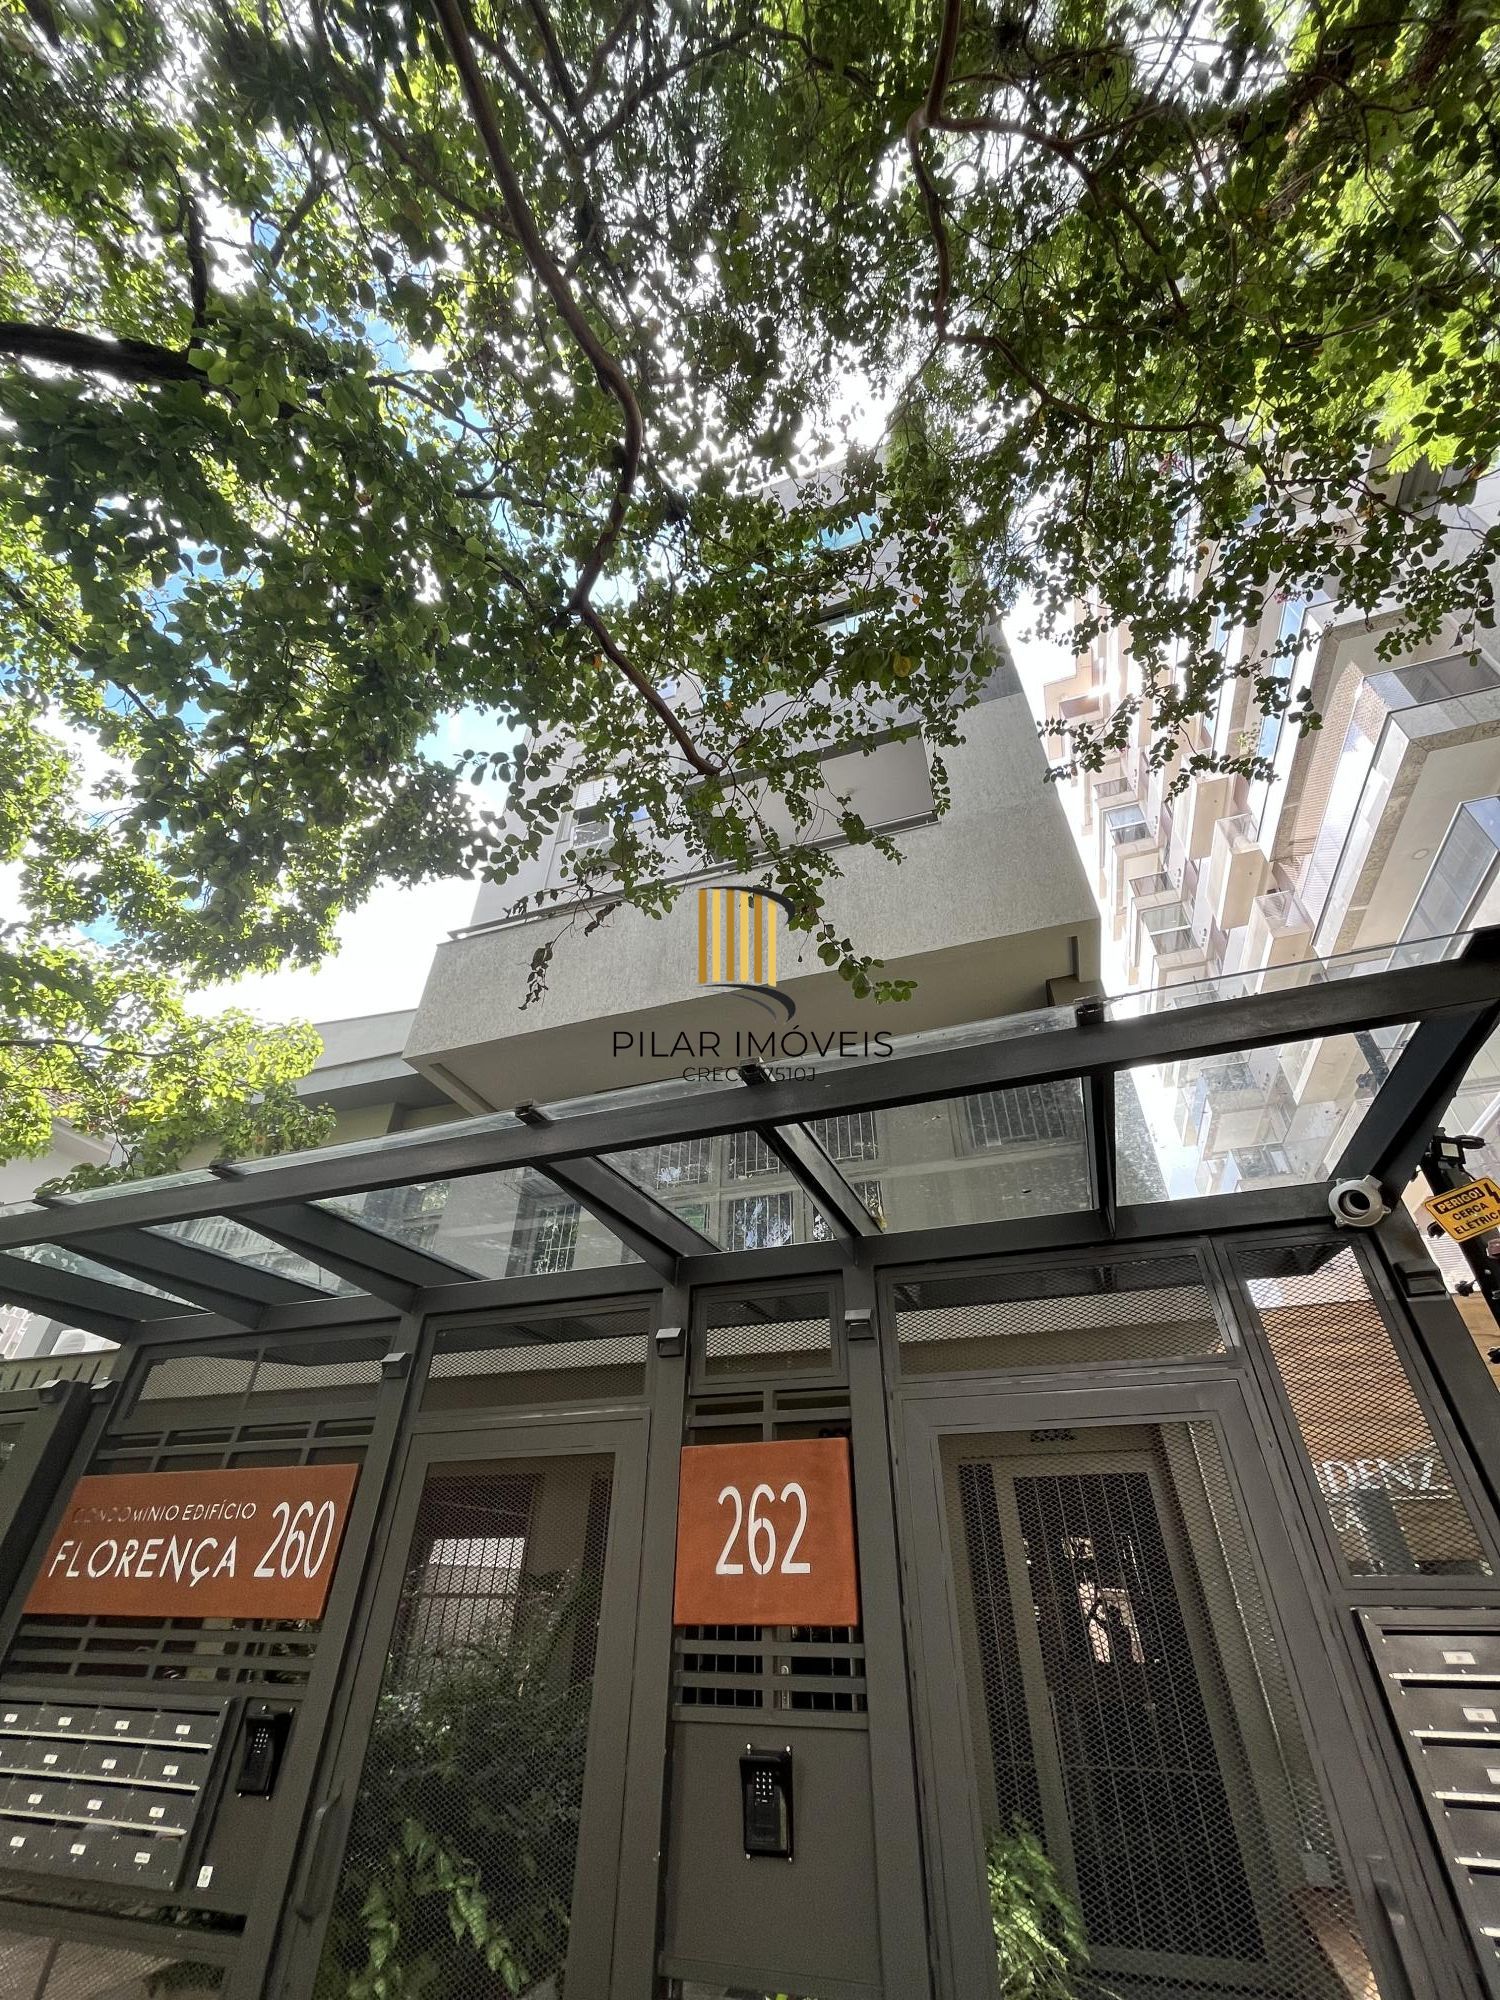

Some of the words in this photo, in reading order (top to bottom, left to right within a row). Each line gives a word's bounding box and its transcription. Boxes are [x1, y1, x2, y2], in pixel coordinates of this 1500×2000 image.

[1436, 1188, 1483, 1212] PERIGO!
[1452, 1202, 1490, 1221] CERCA
[181, 1500, 257, 1521] EDIFÍCIO
[715, 1482, 811, 1575] 262
[253, 1500, 335, 1579] 260
[48, 1534, 238, 1588] FLORENÇA
